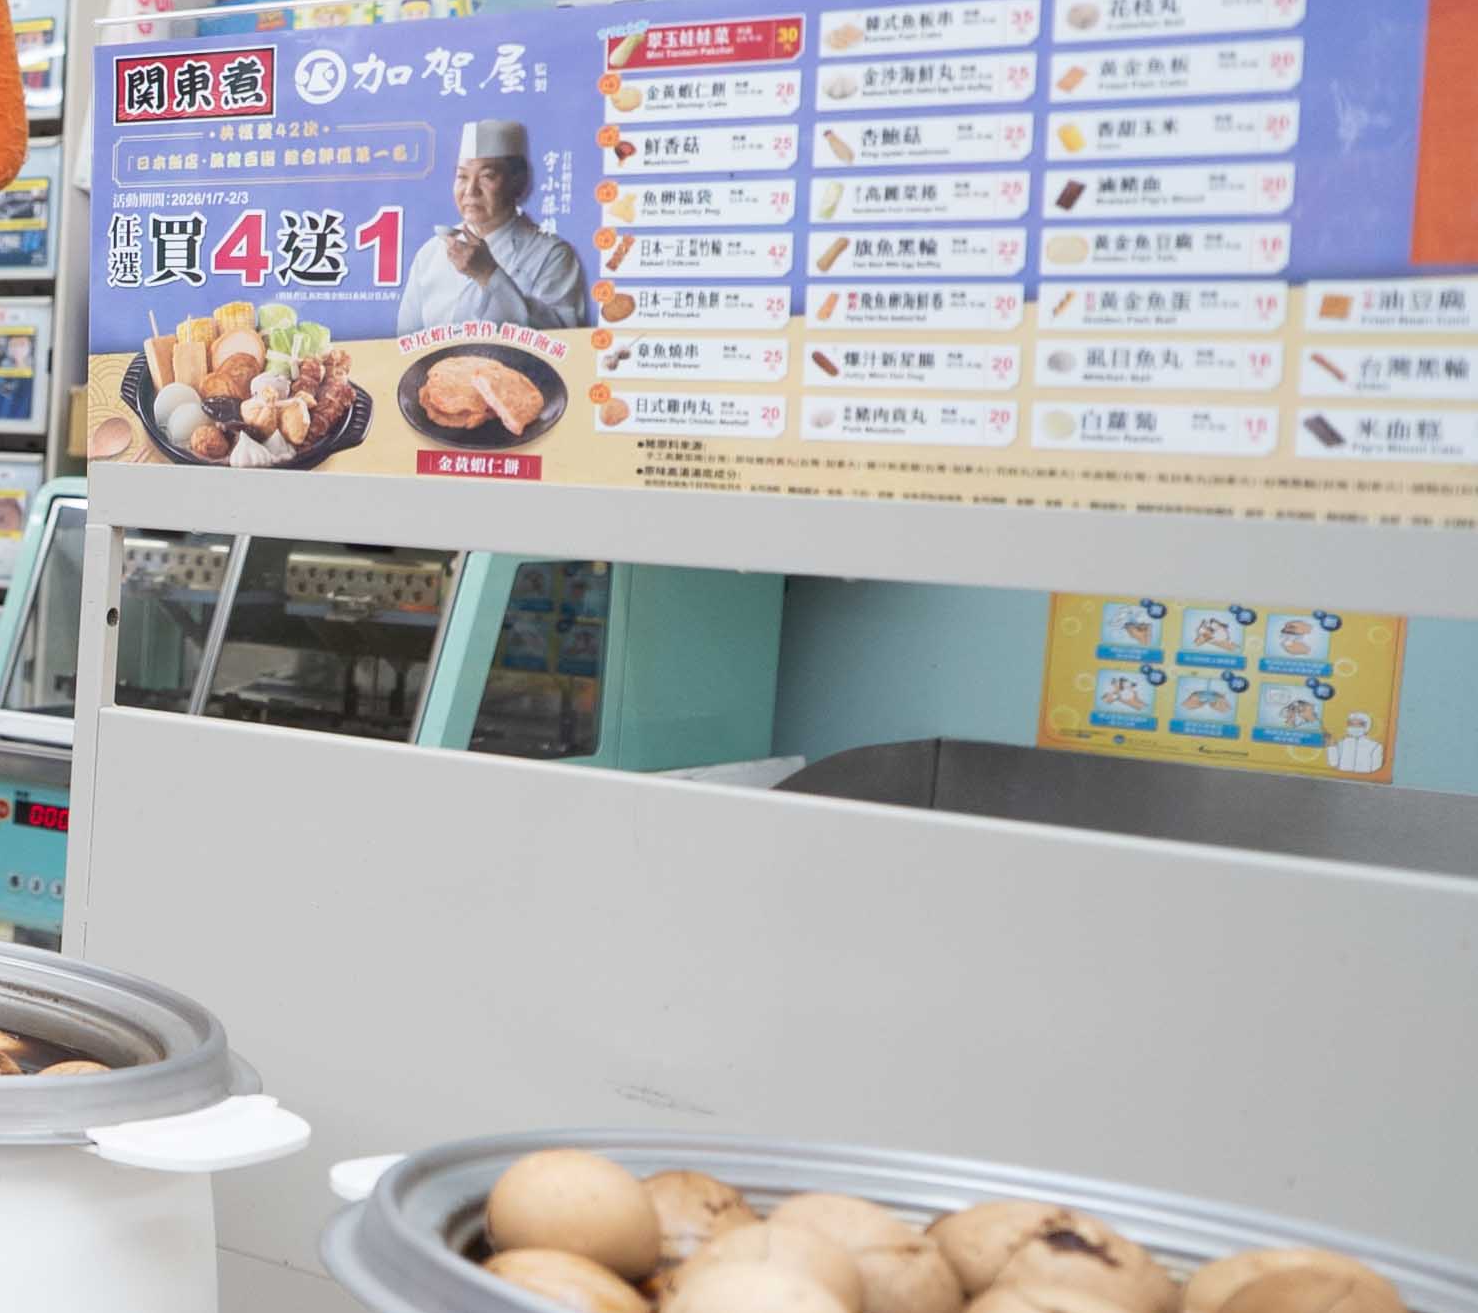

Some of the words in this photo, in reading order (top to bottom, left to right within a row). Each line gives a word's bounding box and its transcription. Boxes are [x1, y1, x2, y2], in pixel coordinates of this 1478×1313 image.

[777, 27, 798, 43] 30
[353, 43, 527, 97] 加賀屋
[773, 137, 792, 151] 25
[148, 206, 403, 286] 買4送1
[766, 297, 785, 311] 25
[763, 350, 783, 363] 25
[761, 406, 780, 420] 20
